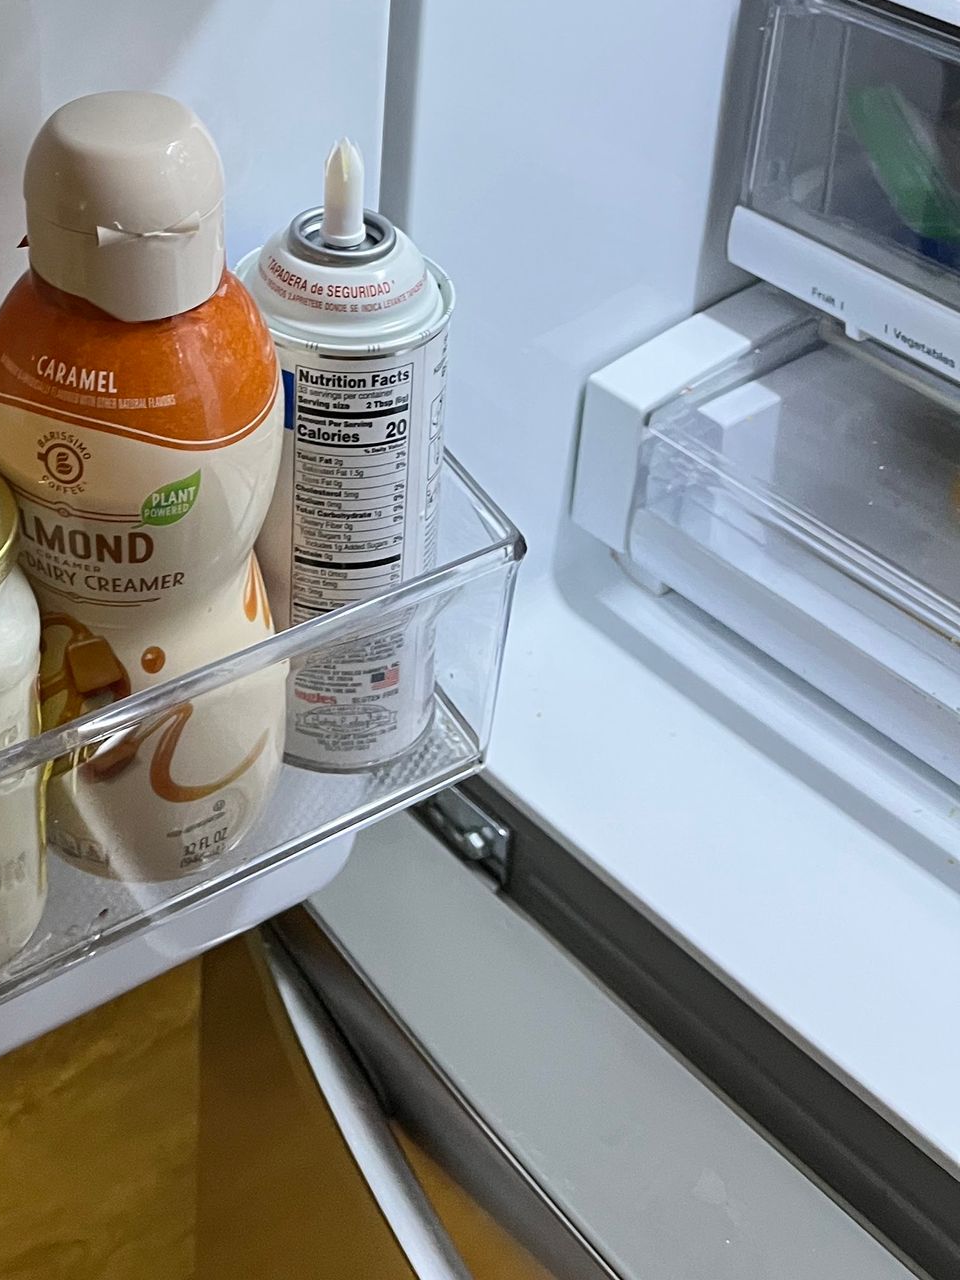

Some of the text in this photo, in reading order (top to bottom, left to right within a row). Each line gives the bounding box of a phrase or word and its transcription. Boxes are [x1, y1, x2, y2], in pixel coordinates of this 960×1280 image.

[311, 283, 323, 295] de
[811, 286, 835, 306] Fruit
[893, 327, 956, 369] Vegetables
[37, 355, 118, 394] CARAMEL
[298, 369, 410, 388] Nutrition Facts
[298, 395, 330, 409] Serving
[332, 402, 350, 410] size
[373, 399, 393, 410] Tbsp
[343, 392, 357, 401] per
[358, 388, 394, 400] container
[297, 418, 407, 443] Calories 20
[343, 420, 373, 428] Serving
[37, 431, 92, 461] BARISSIMO
[319, 456, 333, 465] Fat
[41, 474, 85, 496] COFFEE
[144, 486, 196, 520] PLANT POWERED
[20, 509, 155, 565] LMOND
[84, 572, 186, 594] CREAMER
[199, 836, 210, 850] FL
[214, 826, 228, 844] OZ
